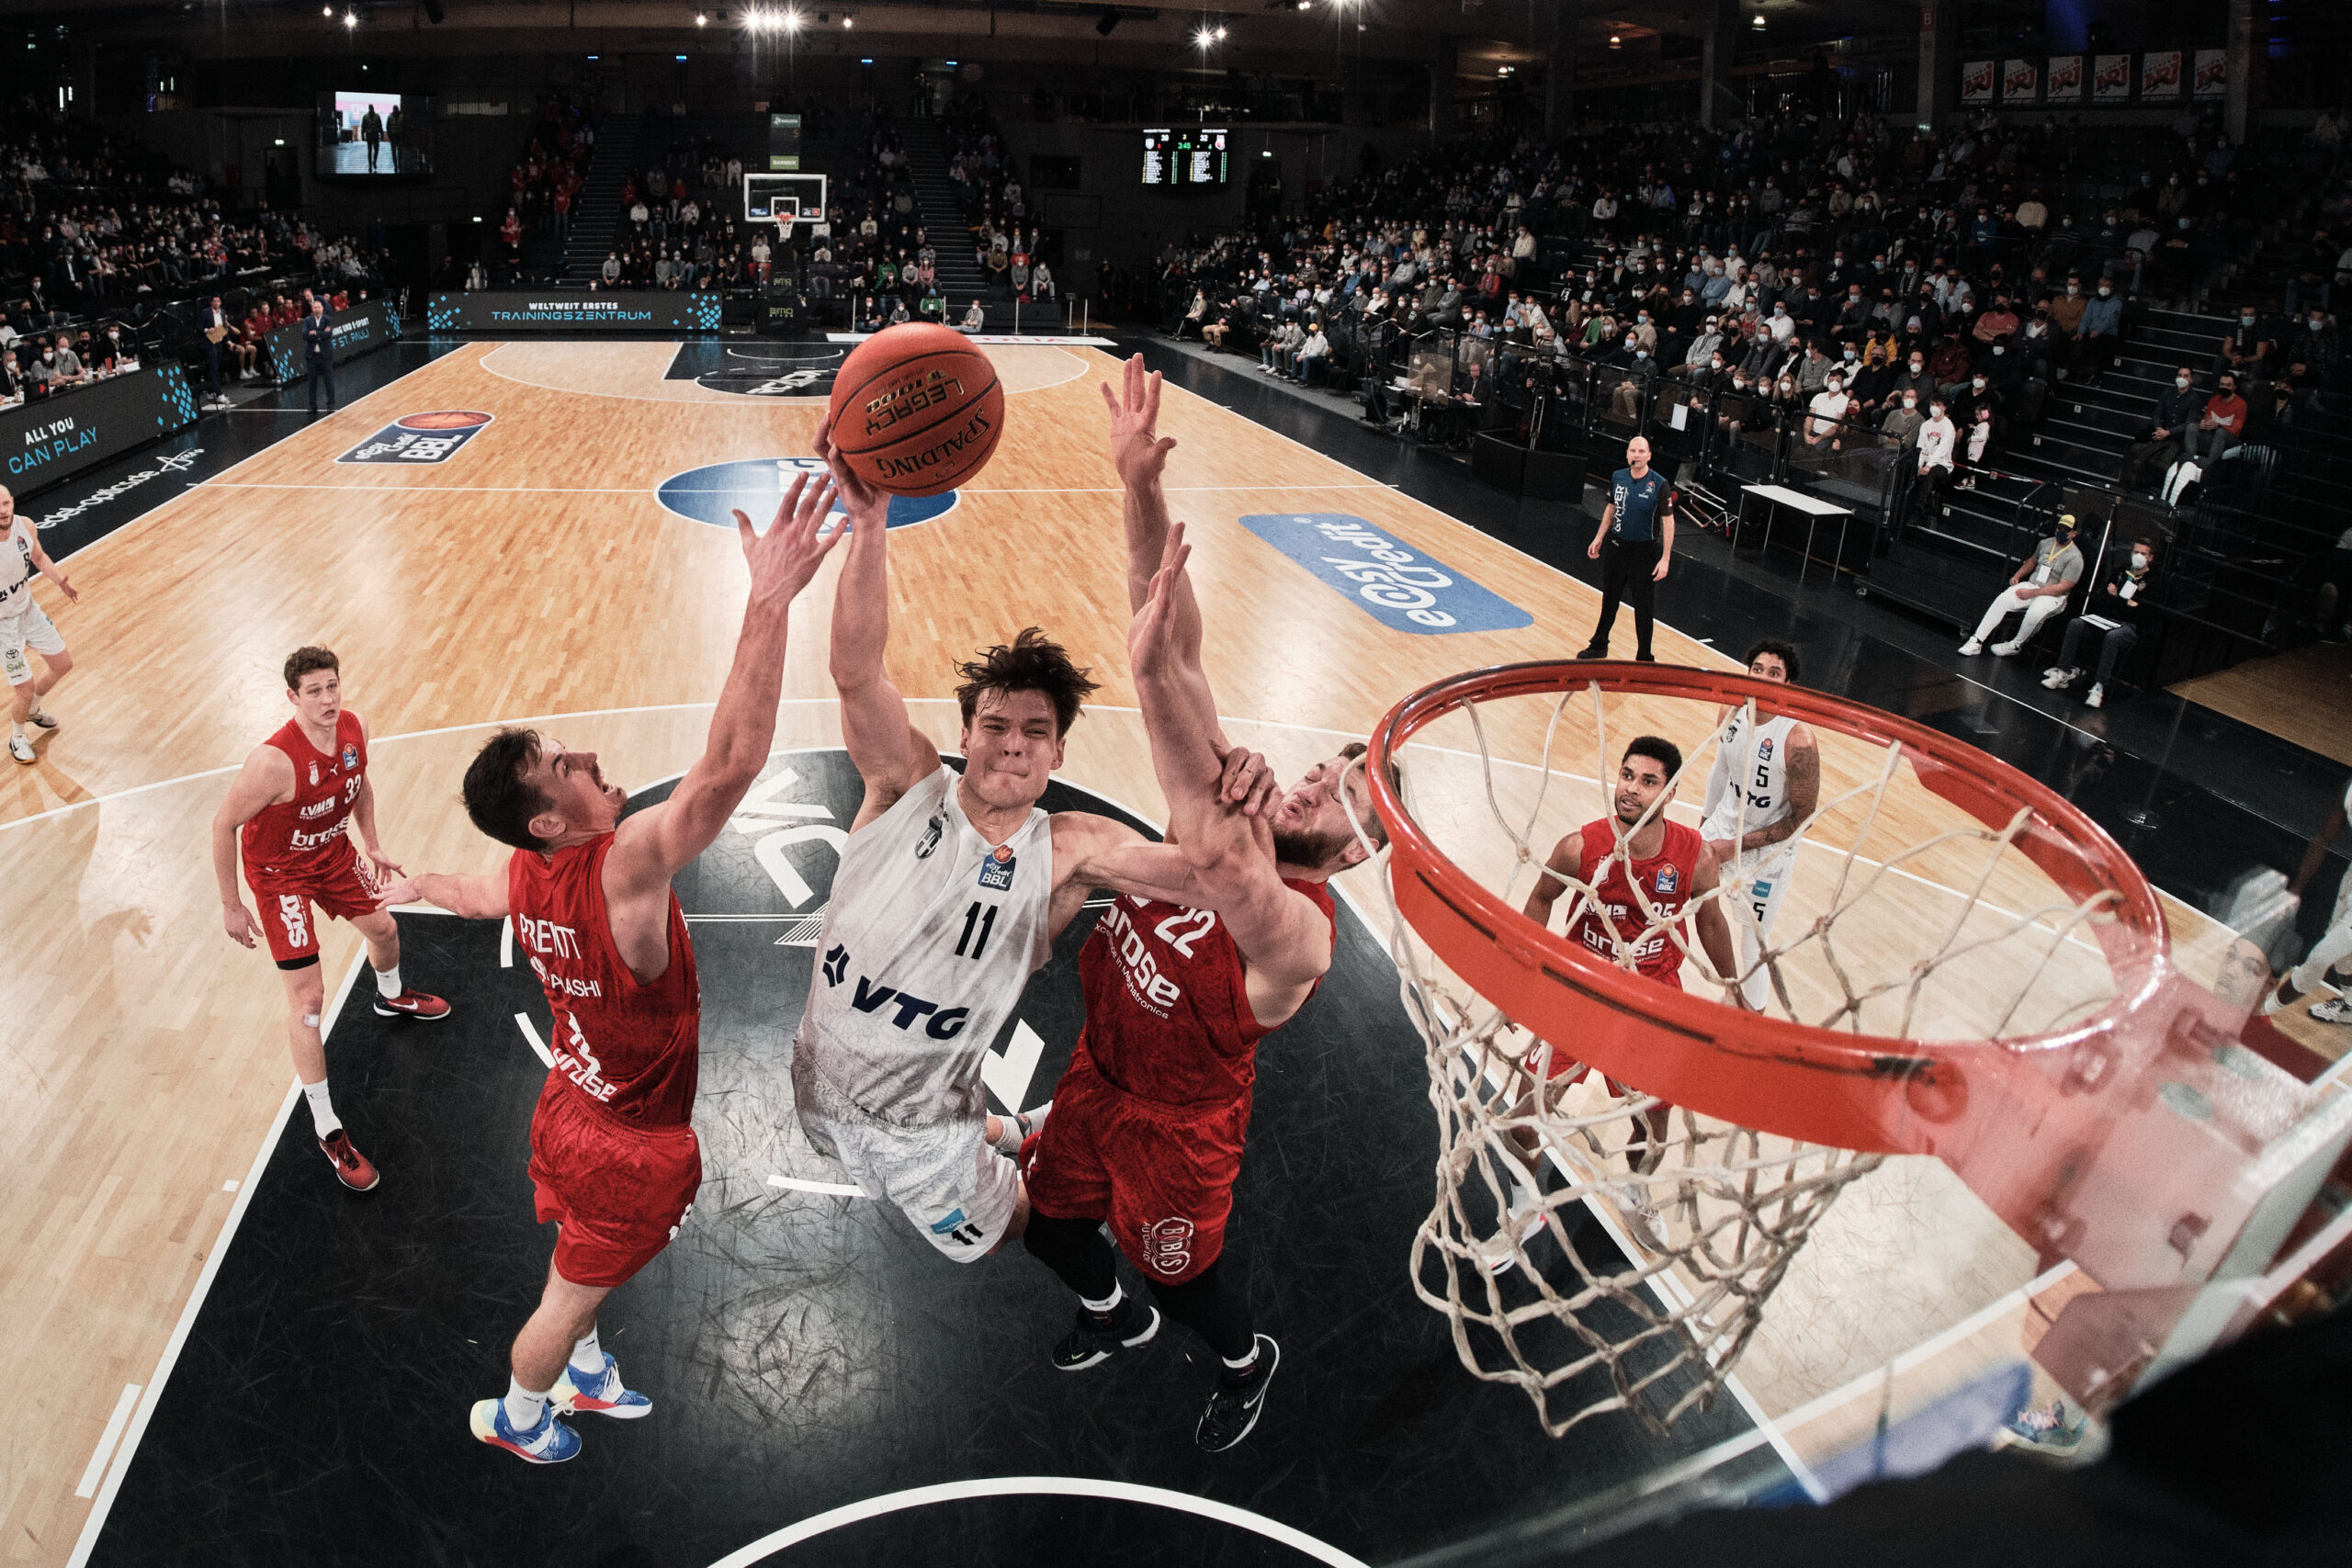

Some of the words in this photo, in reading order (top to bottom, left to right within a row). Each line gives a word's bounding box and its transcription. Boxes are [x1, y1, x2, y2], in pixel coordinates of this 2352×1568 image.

[2196, 61, 2227, 90] NR
[492, 311, 651, 321] TRAININGSZENTRUM
[528, 302, 580, 310] WELTWEIT
[865, 378, 965, 436] LEGACY
[25, 427, 48, 446] ALL
[49, 417, 74, 435] YOU
[876, 405, 990, 479] SPALDING
[8, 446, 51, 475] CAN
[53, 426, 98, 457] PLAY
[398, 434, 464, 460] BBL
[1756, 764, 1769, 787] 5
[300, 799, 327, 817] LVM
[981, 873, 1009, 888] BBL
[1657, 883, 1674, 892] BBL
[955, 901, 999, 960] 11
[1154, 906, 1216, 960] 22
[852, 975, 970, 1041] VTG
[951, 1223, 984, 1246] 11
